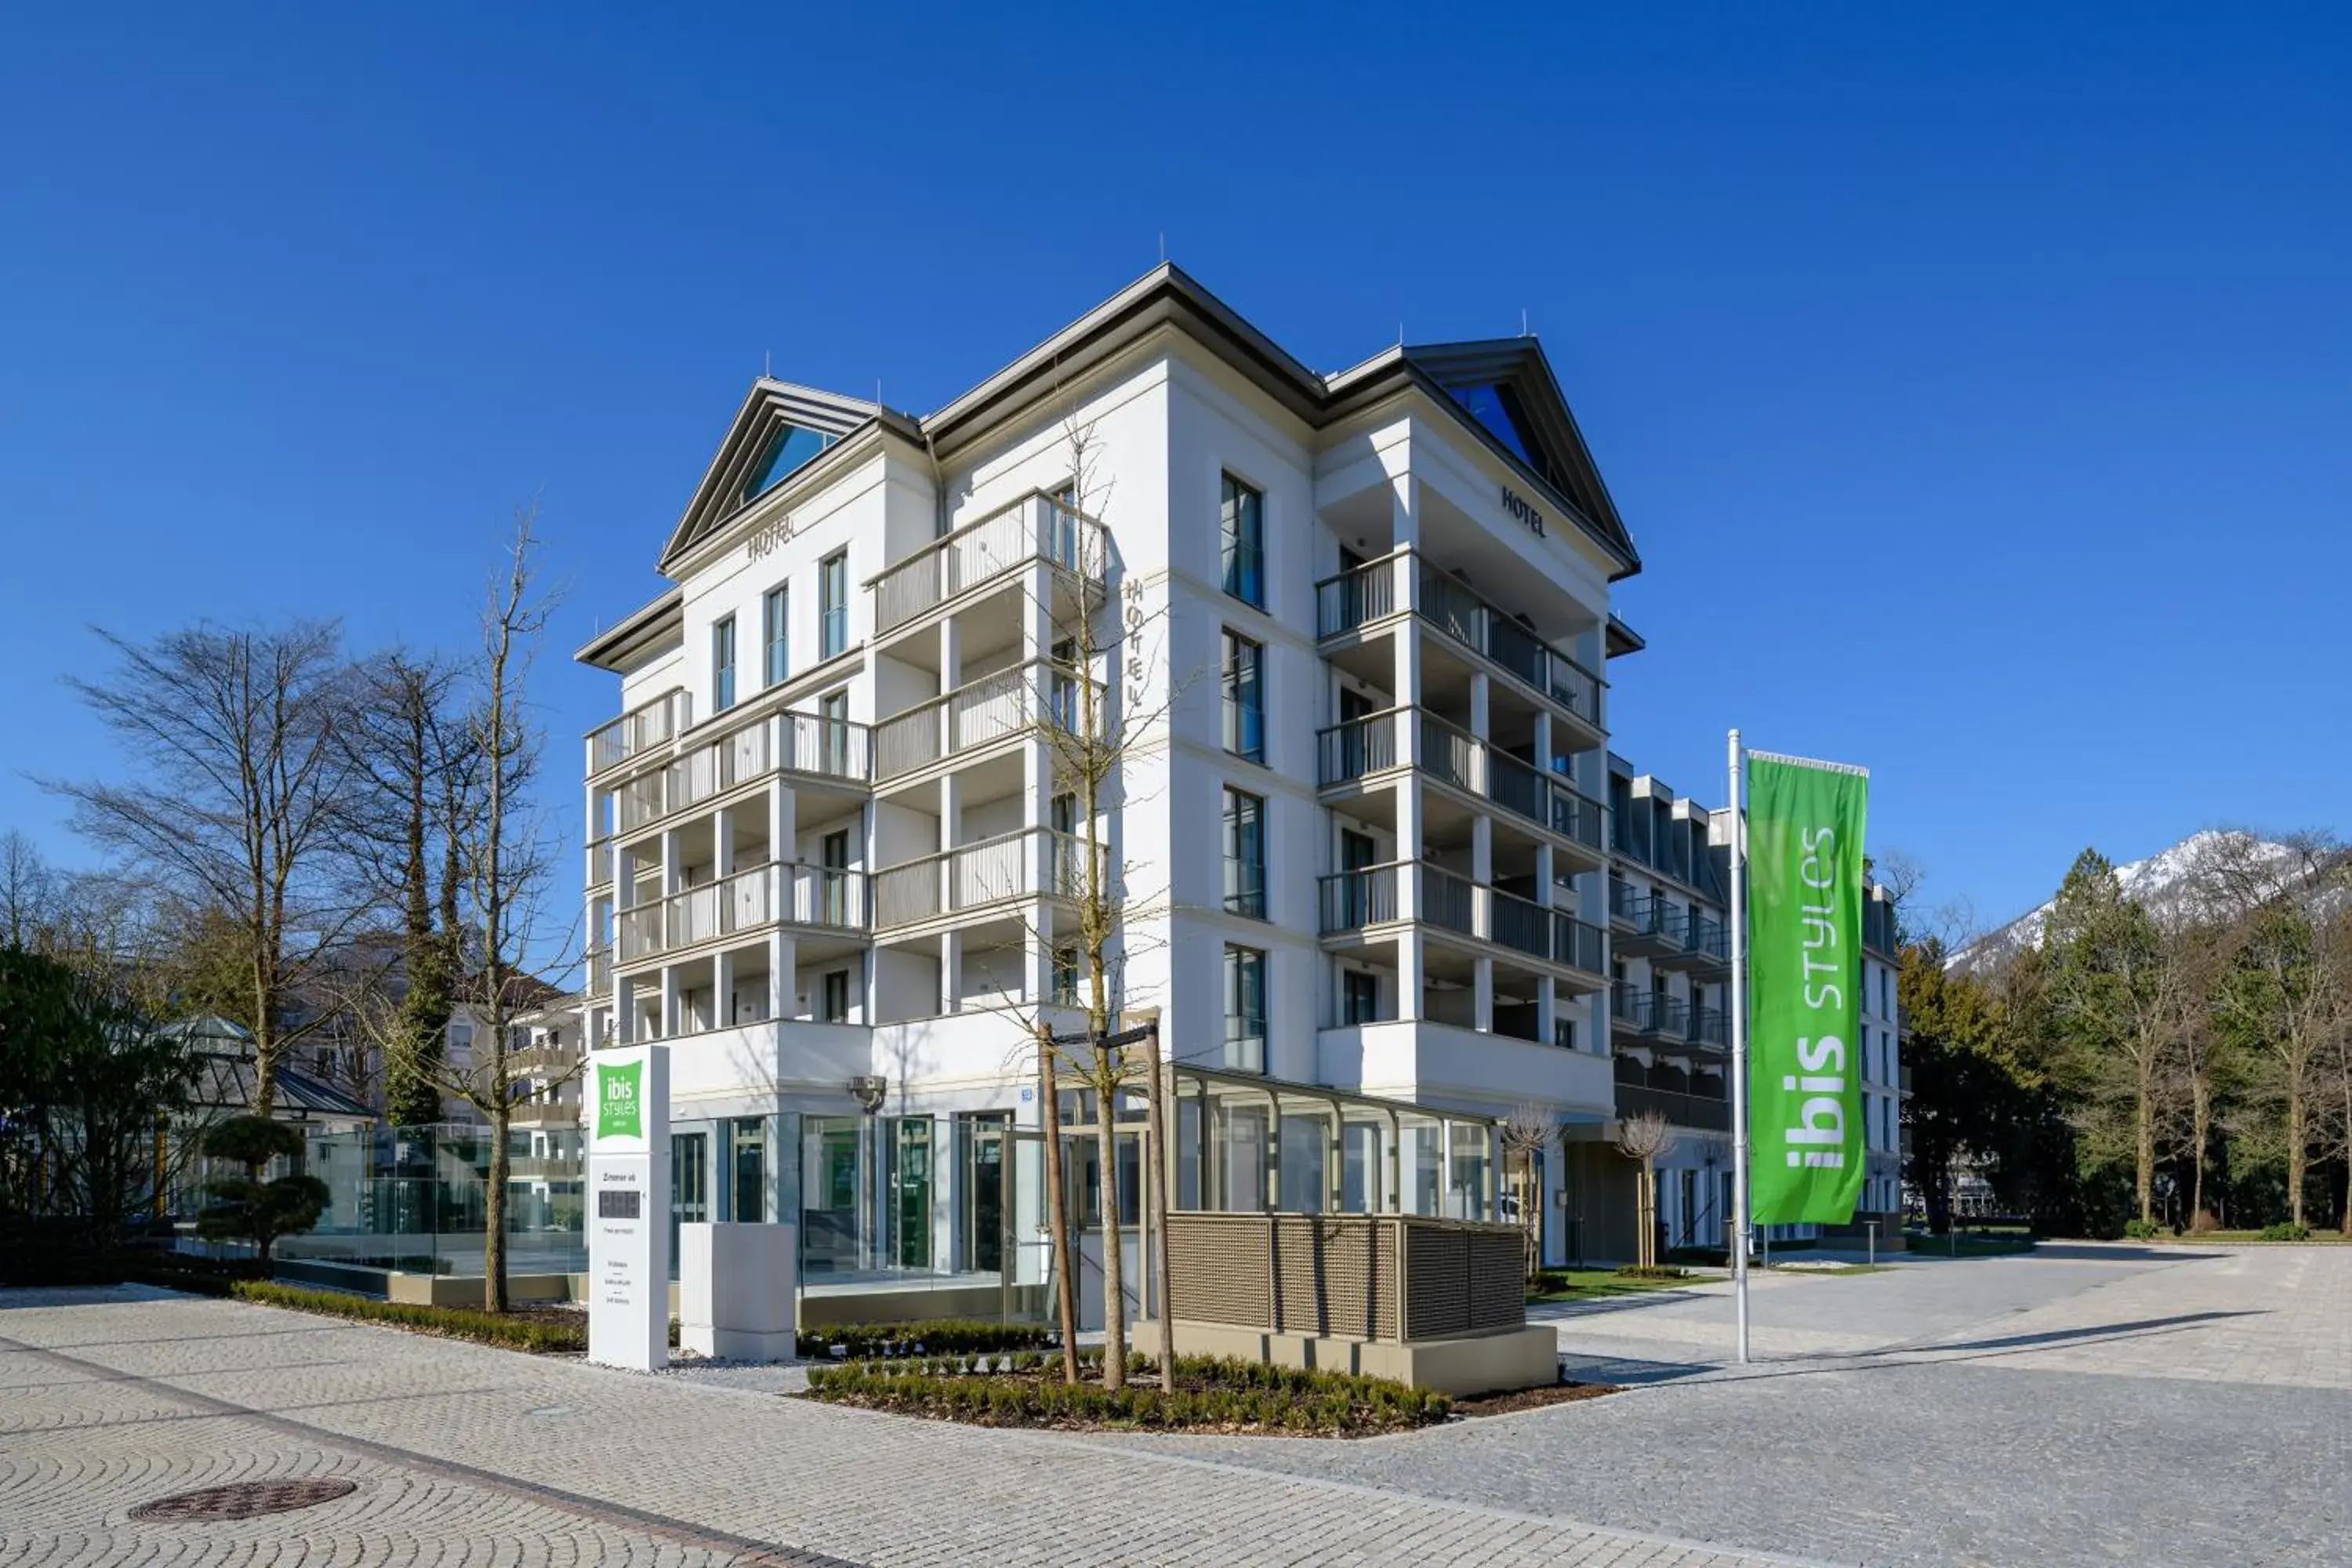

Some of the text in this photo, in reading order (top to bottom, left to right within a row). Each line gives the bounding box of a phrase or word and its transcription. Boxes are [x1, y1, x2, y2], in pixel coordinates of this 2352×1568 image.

[747, 515, 793, 561] HOTEL
[1503, 485, 1546, 539] HOTEL
[1122, 579, 1142, 706] HOTEL
[608, 1073, 633, 1101] ibis
[1784, 1036, 1844, 1167] ibis
